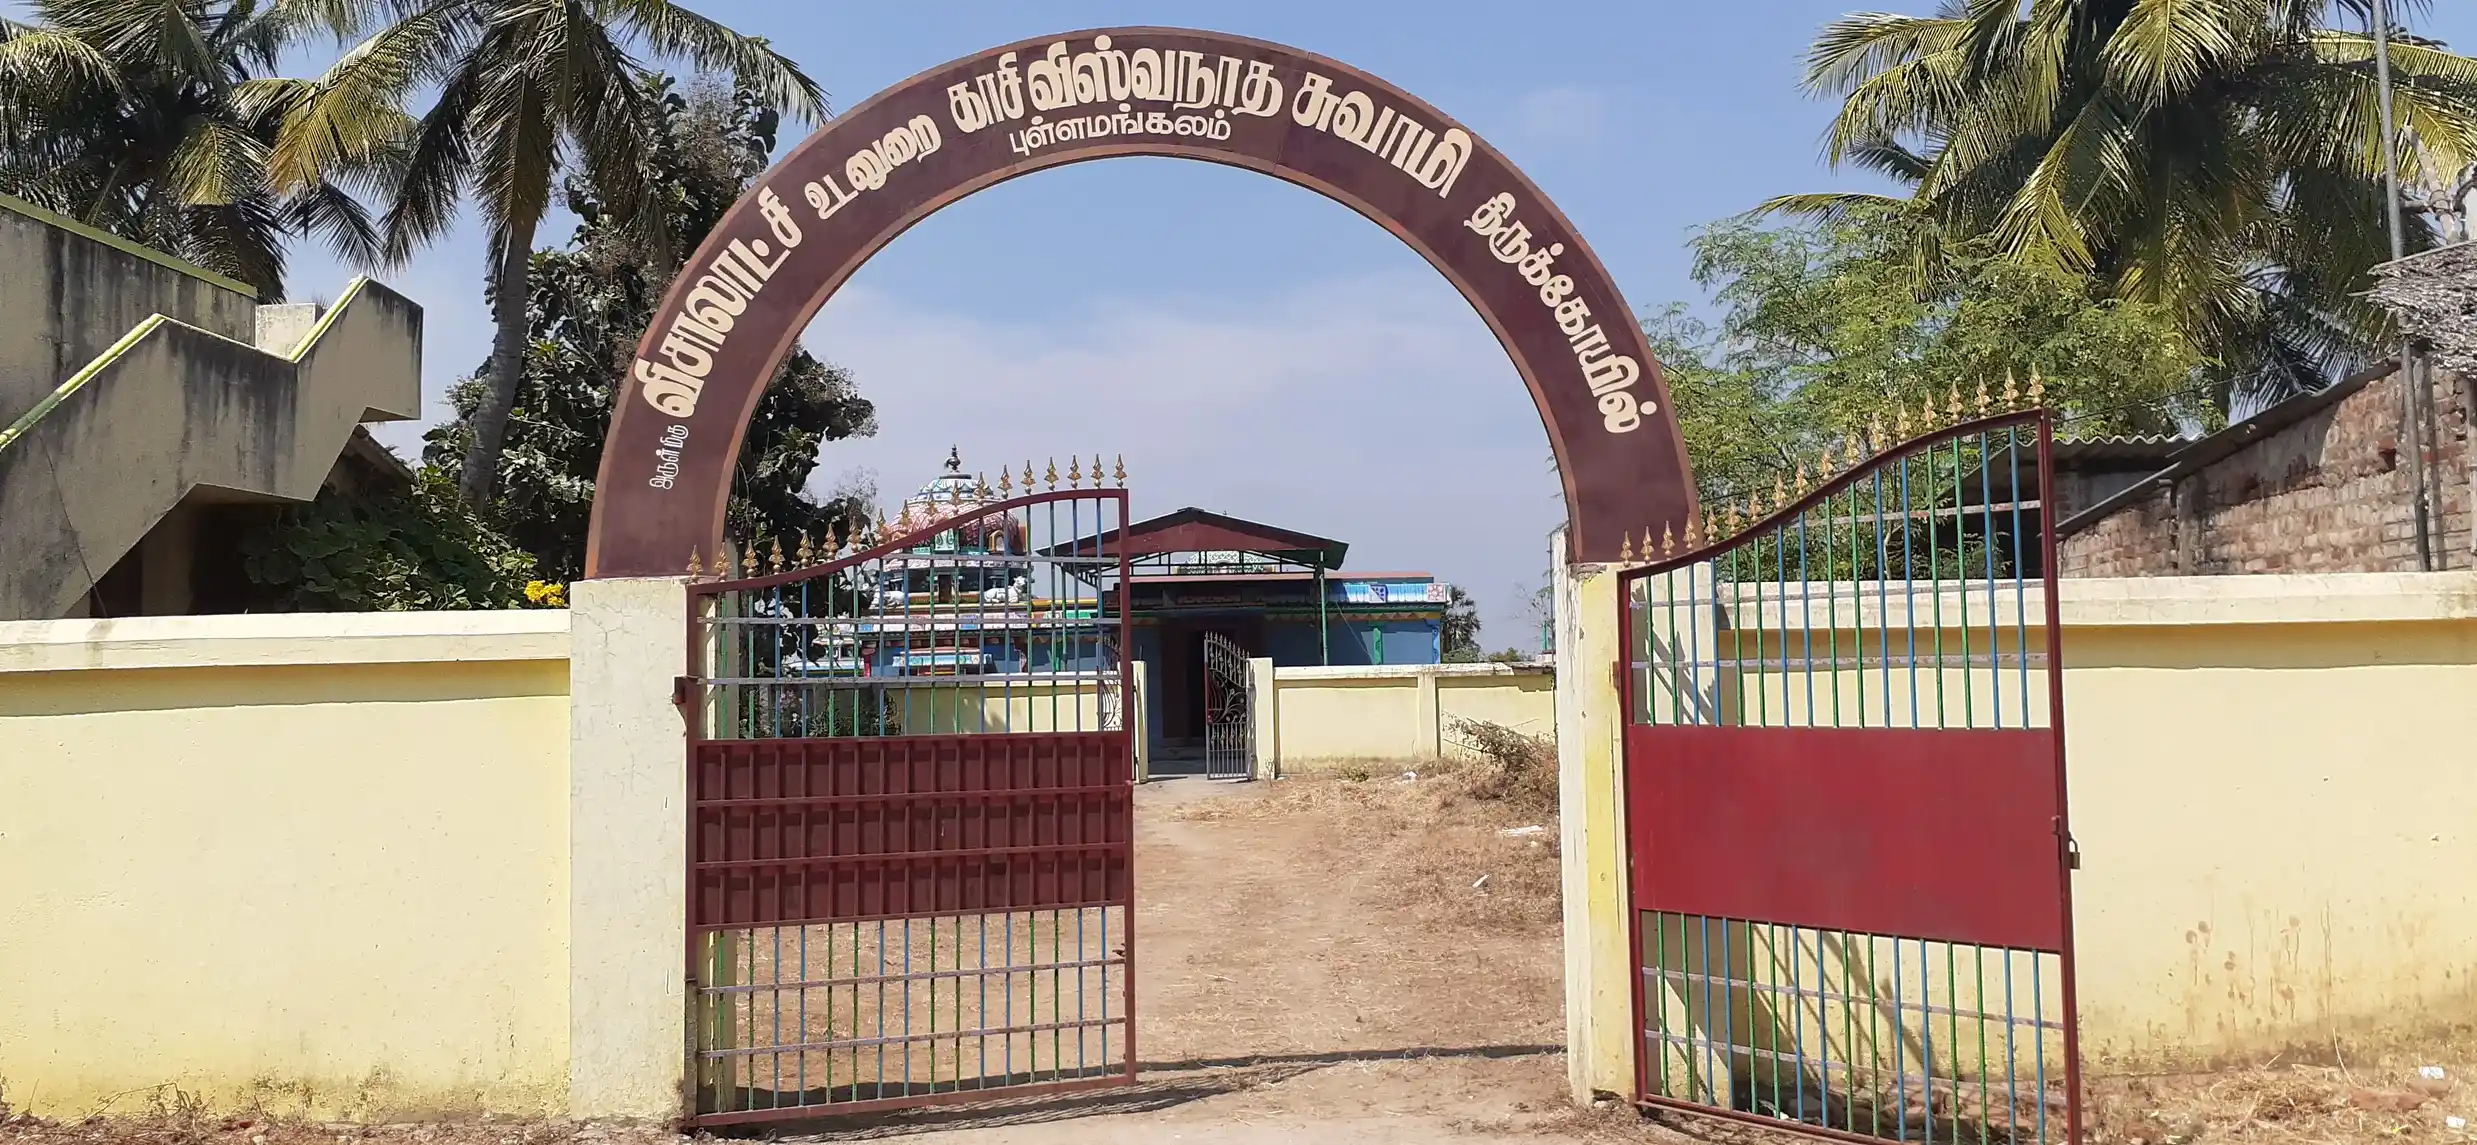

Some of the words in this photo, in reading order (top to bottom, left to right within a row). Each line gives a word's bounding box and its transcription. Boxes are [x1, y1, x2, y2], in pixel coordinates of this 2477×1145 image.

[1009, 102, 1232, 157] புள்ளமங்கலம்
[634, 185, 804, 418] விசாலாட்சி
[804, 113, 942, 220] உடனுறை
[1291, 70, 1474, 200] சுவாமி
[1463, 191, 1658, 435] திருக்கோயில்
